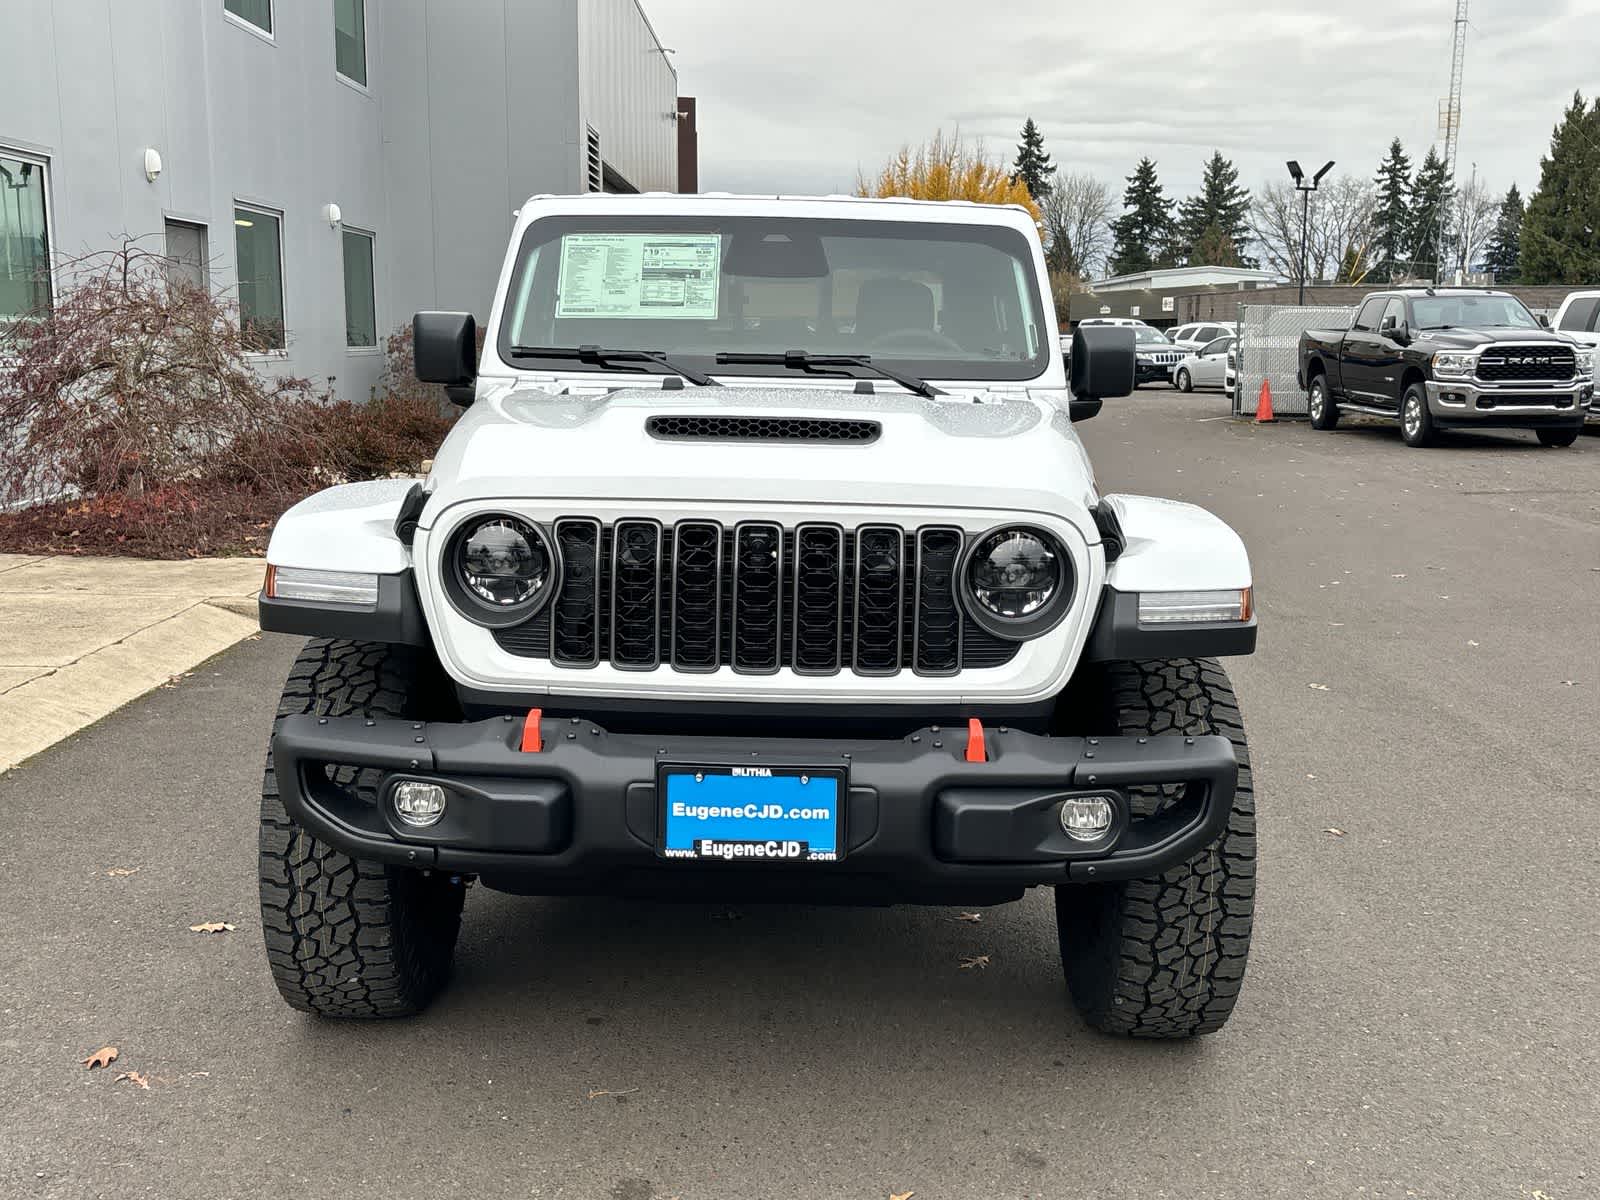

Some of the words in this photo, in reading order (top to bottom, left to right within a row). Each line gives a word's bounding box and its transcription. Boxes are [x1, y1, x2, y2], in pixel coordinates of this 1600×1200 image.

[1508, 357, 1550, 365] RAM
[741, 767, 772, 777] LITHIA
[672, 802, 830, 820] EugeneCJD.com
[665, 848, 698, 858] www.
[701, 839, 800, 859] EugeneCJD
[806, 851, 837, 861] .com
